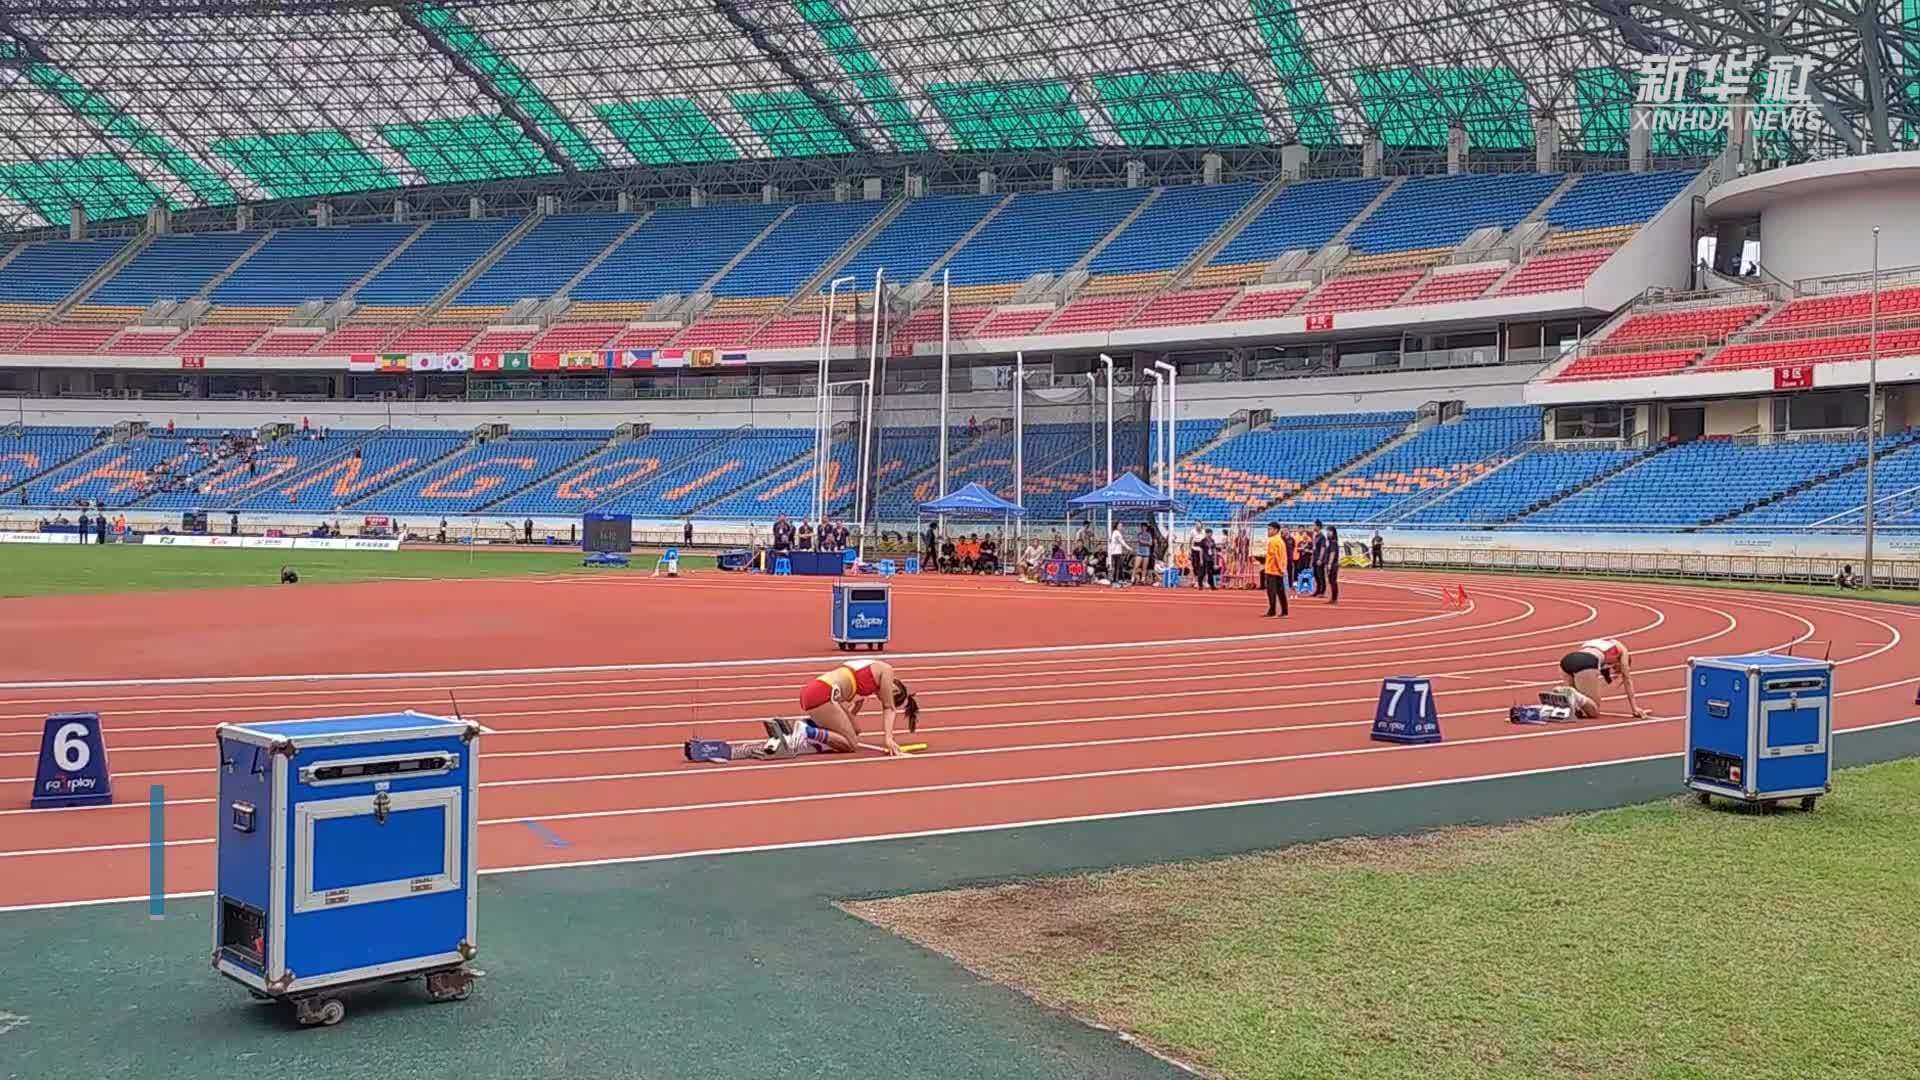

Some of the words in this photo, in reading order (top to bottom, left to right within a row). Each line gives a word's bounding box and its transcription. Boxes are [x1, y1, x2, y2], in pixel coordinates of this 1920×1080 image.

[1386, 683, 1405, 717] 7
[1414, 683, 1429, 717] 7
[53, 722, 90, 771] 6
